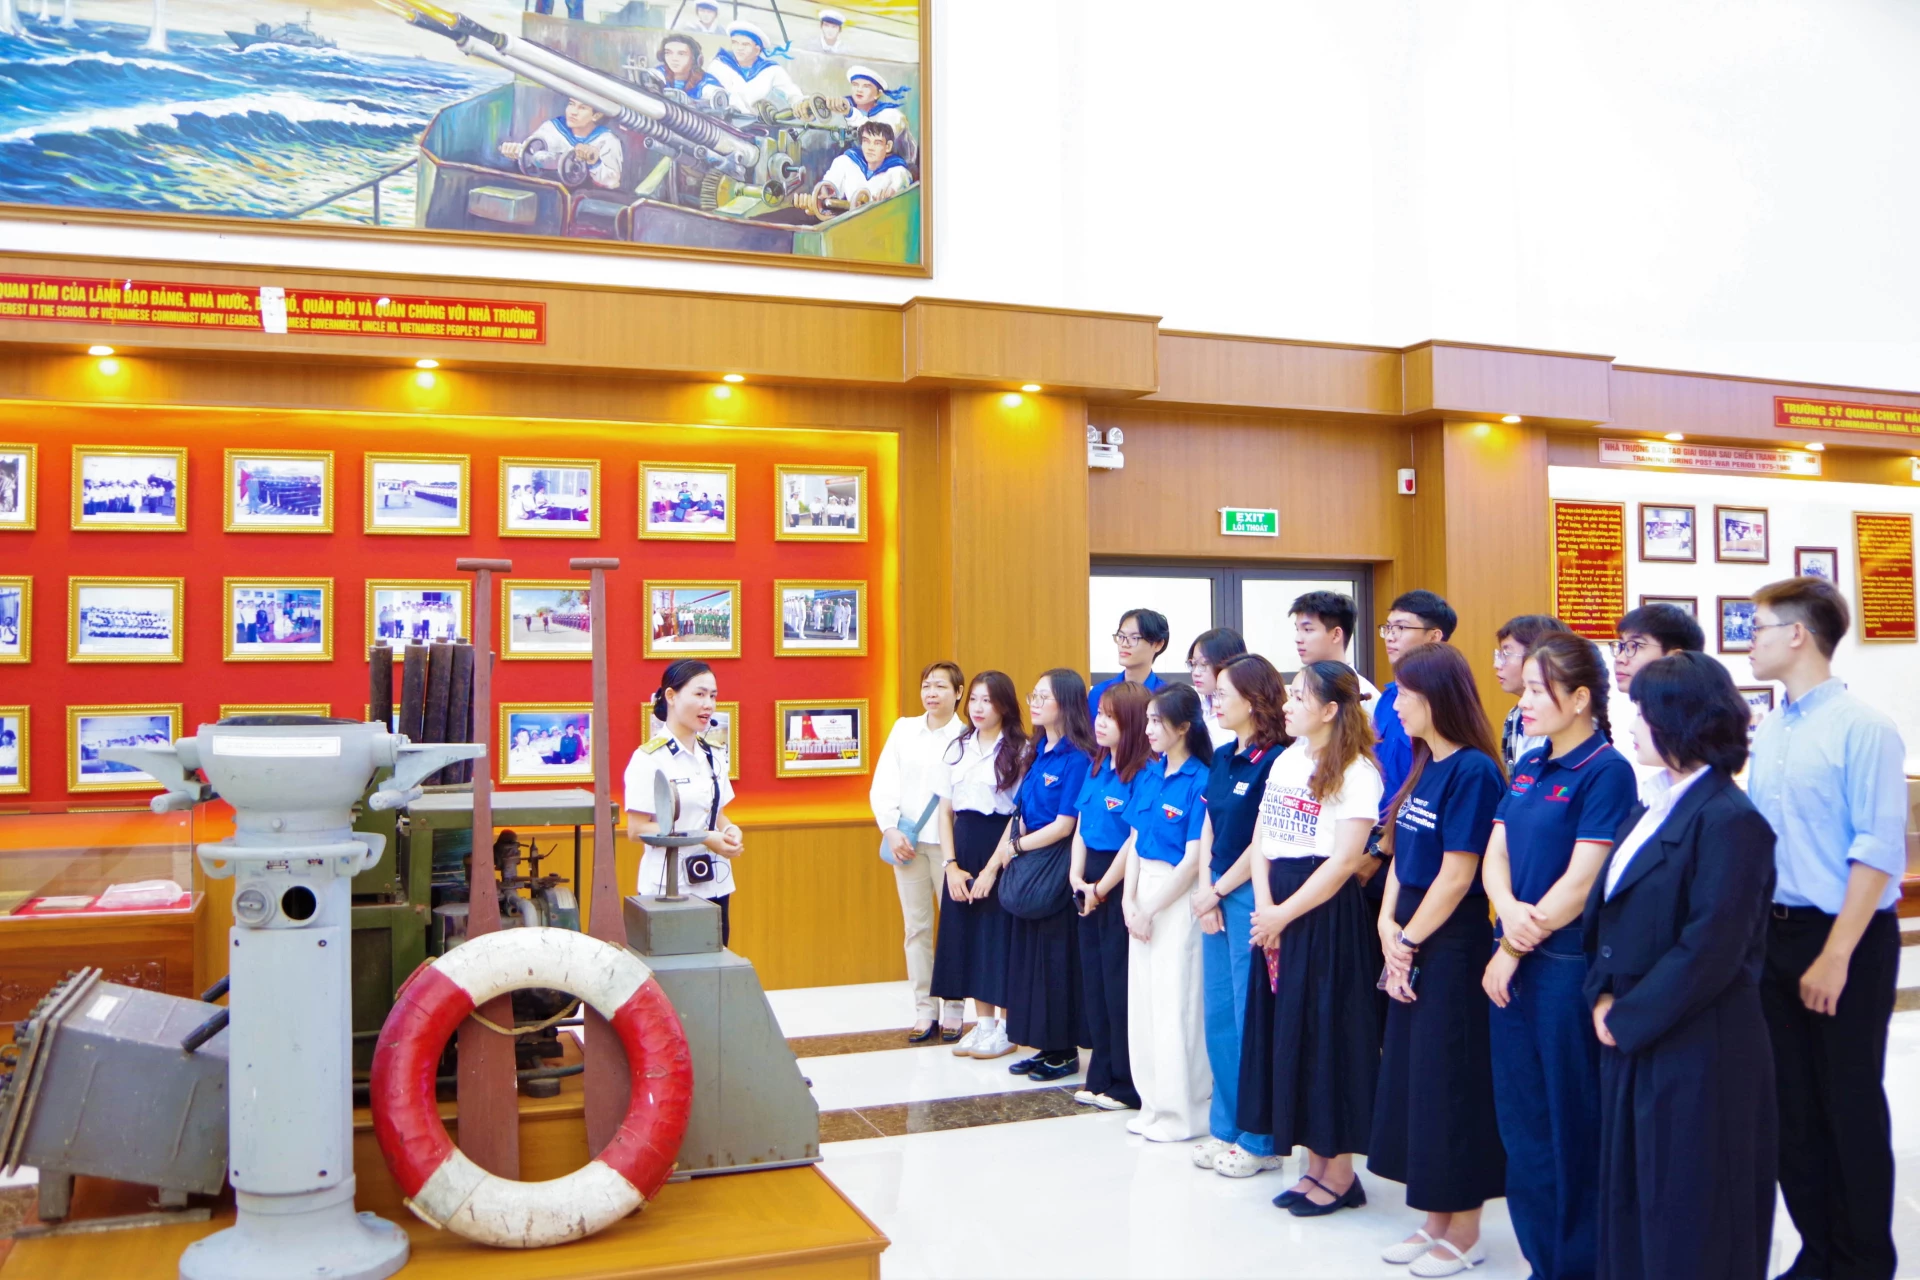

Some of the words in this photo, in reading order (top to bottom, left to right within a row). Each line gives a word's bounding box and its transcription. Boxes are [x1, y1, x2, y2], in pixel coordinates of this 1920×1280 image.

[32, 282, 58, 300] TÂM
[61, 282, 86, 301] CỦA
[89, 285, 121, 303] LÃNH
[123, 289, 148, 307] ĐẠO
[151, 286, 186, 308] ĐẢNG,
[190, 291, 214, 308] NHÀ
[217, 292, 252, 311] NƯỚC,
[303, 297, 334, 314] QUÂN
[336, 298, 356, 318] ĐỘI
[358, 299, 373, 316] VÀ
[448, 304, 465, 320] VỚI
[468, 305, 491, 322] NHÀ
[493, 306, 535, 324] TRƯỜNG
[29, 304, 38, 316] IN
[40, 304, 55, 316] THE
[56, 305, 87, 318] SCHOOL
[89, 306, 100, 318] OF
[101, 307, 150, 320] VIETNAMESE
[152, 310, 199, 323] COMMUNIST
[201, 313, 224, 324] PARTY
[400, 322, 445, 335] VIETNAMESE
[446, 324, 480, 337] PEOPLE'S
[481, 326, 501, 337] ARMY
[503, 328, 518, 339] AND
[519, 328, 537, 339] NAVY
[1783, 402, 1826, 416] TRƯỜNG
[1845, 408, 1874, 419] QUAN
[1876, 410, 1901, 421] CHKT
[1790, 416, 1821, 426] SCHOOL
[1823, 418, 1832, 426] OF
[1835, 419, 1885, 430] COMMANDER
[1886, 423, 1910, 433] NAVAL
[1236, 512, 1264, 522] EXIT
[1233, 521, 1245, 530] LỐI
[1246, 523, 1268, 532] THOÁT
[1284, 797, 1300, 808] SINCE
[1263, 815, 1316, 836] UMANITIES
[1293, 811, 1318, 825] AND
